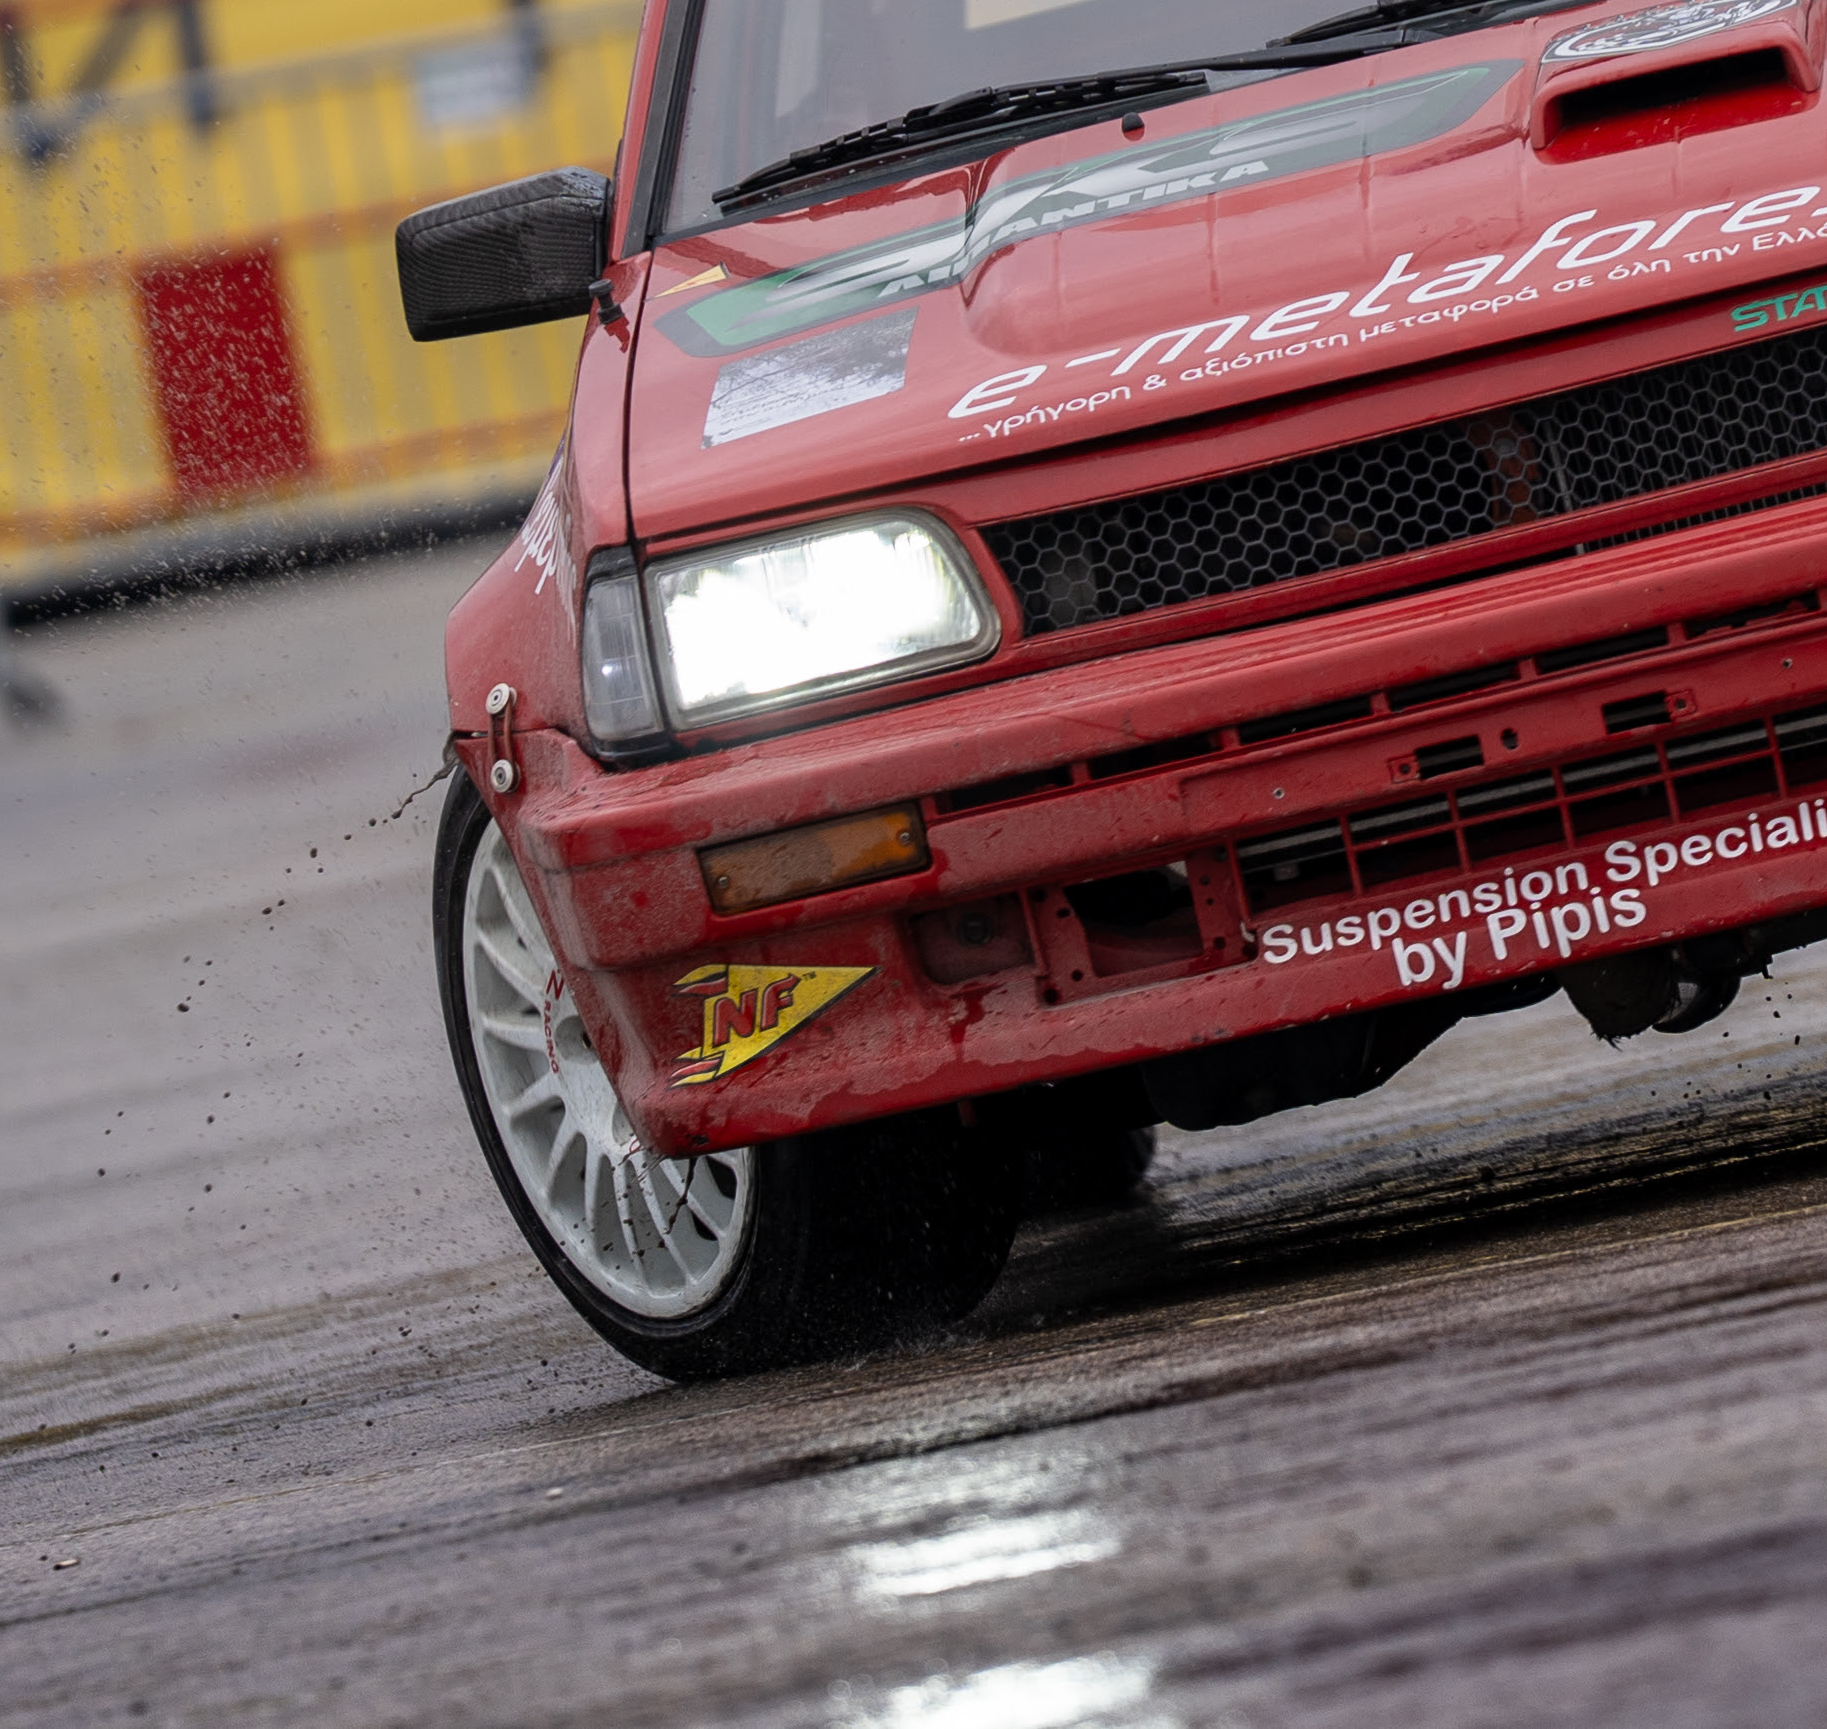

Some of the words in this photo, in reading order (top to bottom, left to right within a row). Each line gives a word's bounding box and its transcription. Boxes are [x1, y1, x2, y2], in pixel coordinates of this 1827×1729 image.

[1142, 373, 1168, 391] &
[1179, 332, 1350, 381] αξιόπιστη
[1359, 284, 1540, 343] μεταφορά
[1552, 275, 1596, 292] σε
[1607, 256, 1672, 280] όλη
[1682, 242, 1741, 264] την
[1262, 859, 1590, 965] Suspension
[1392, 930, 1468, 991] by
[1486, 884, 1648, 961] Pipis
[710, 972, 802, 1049] NF
